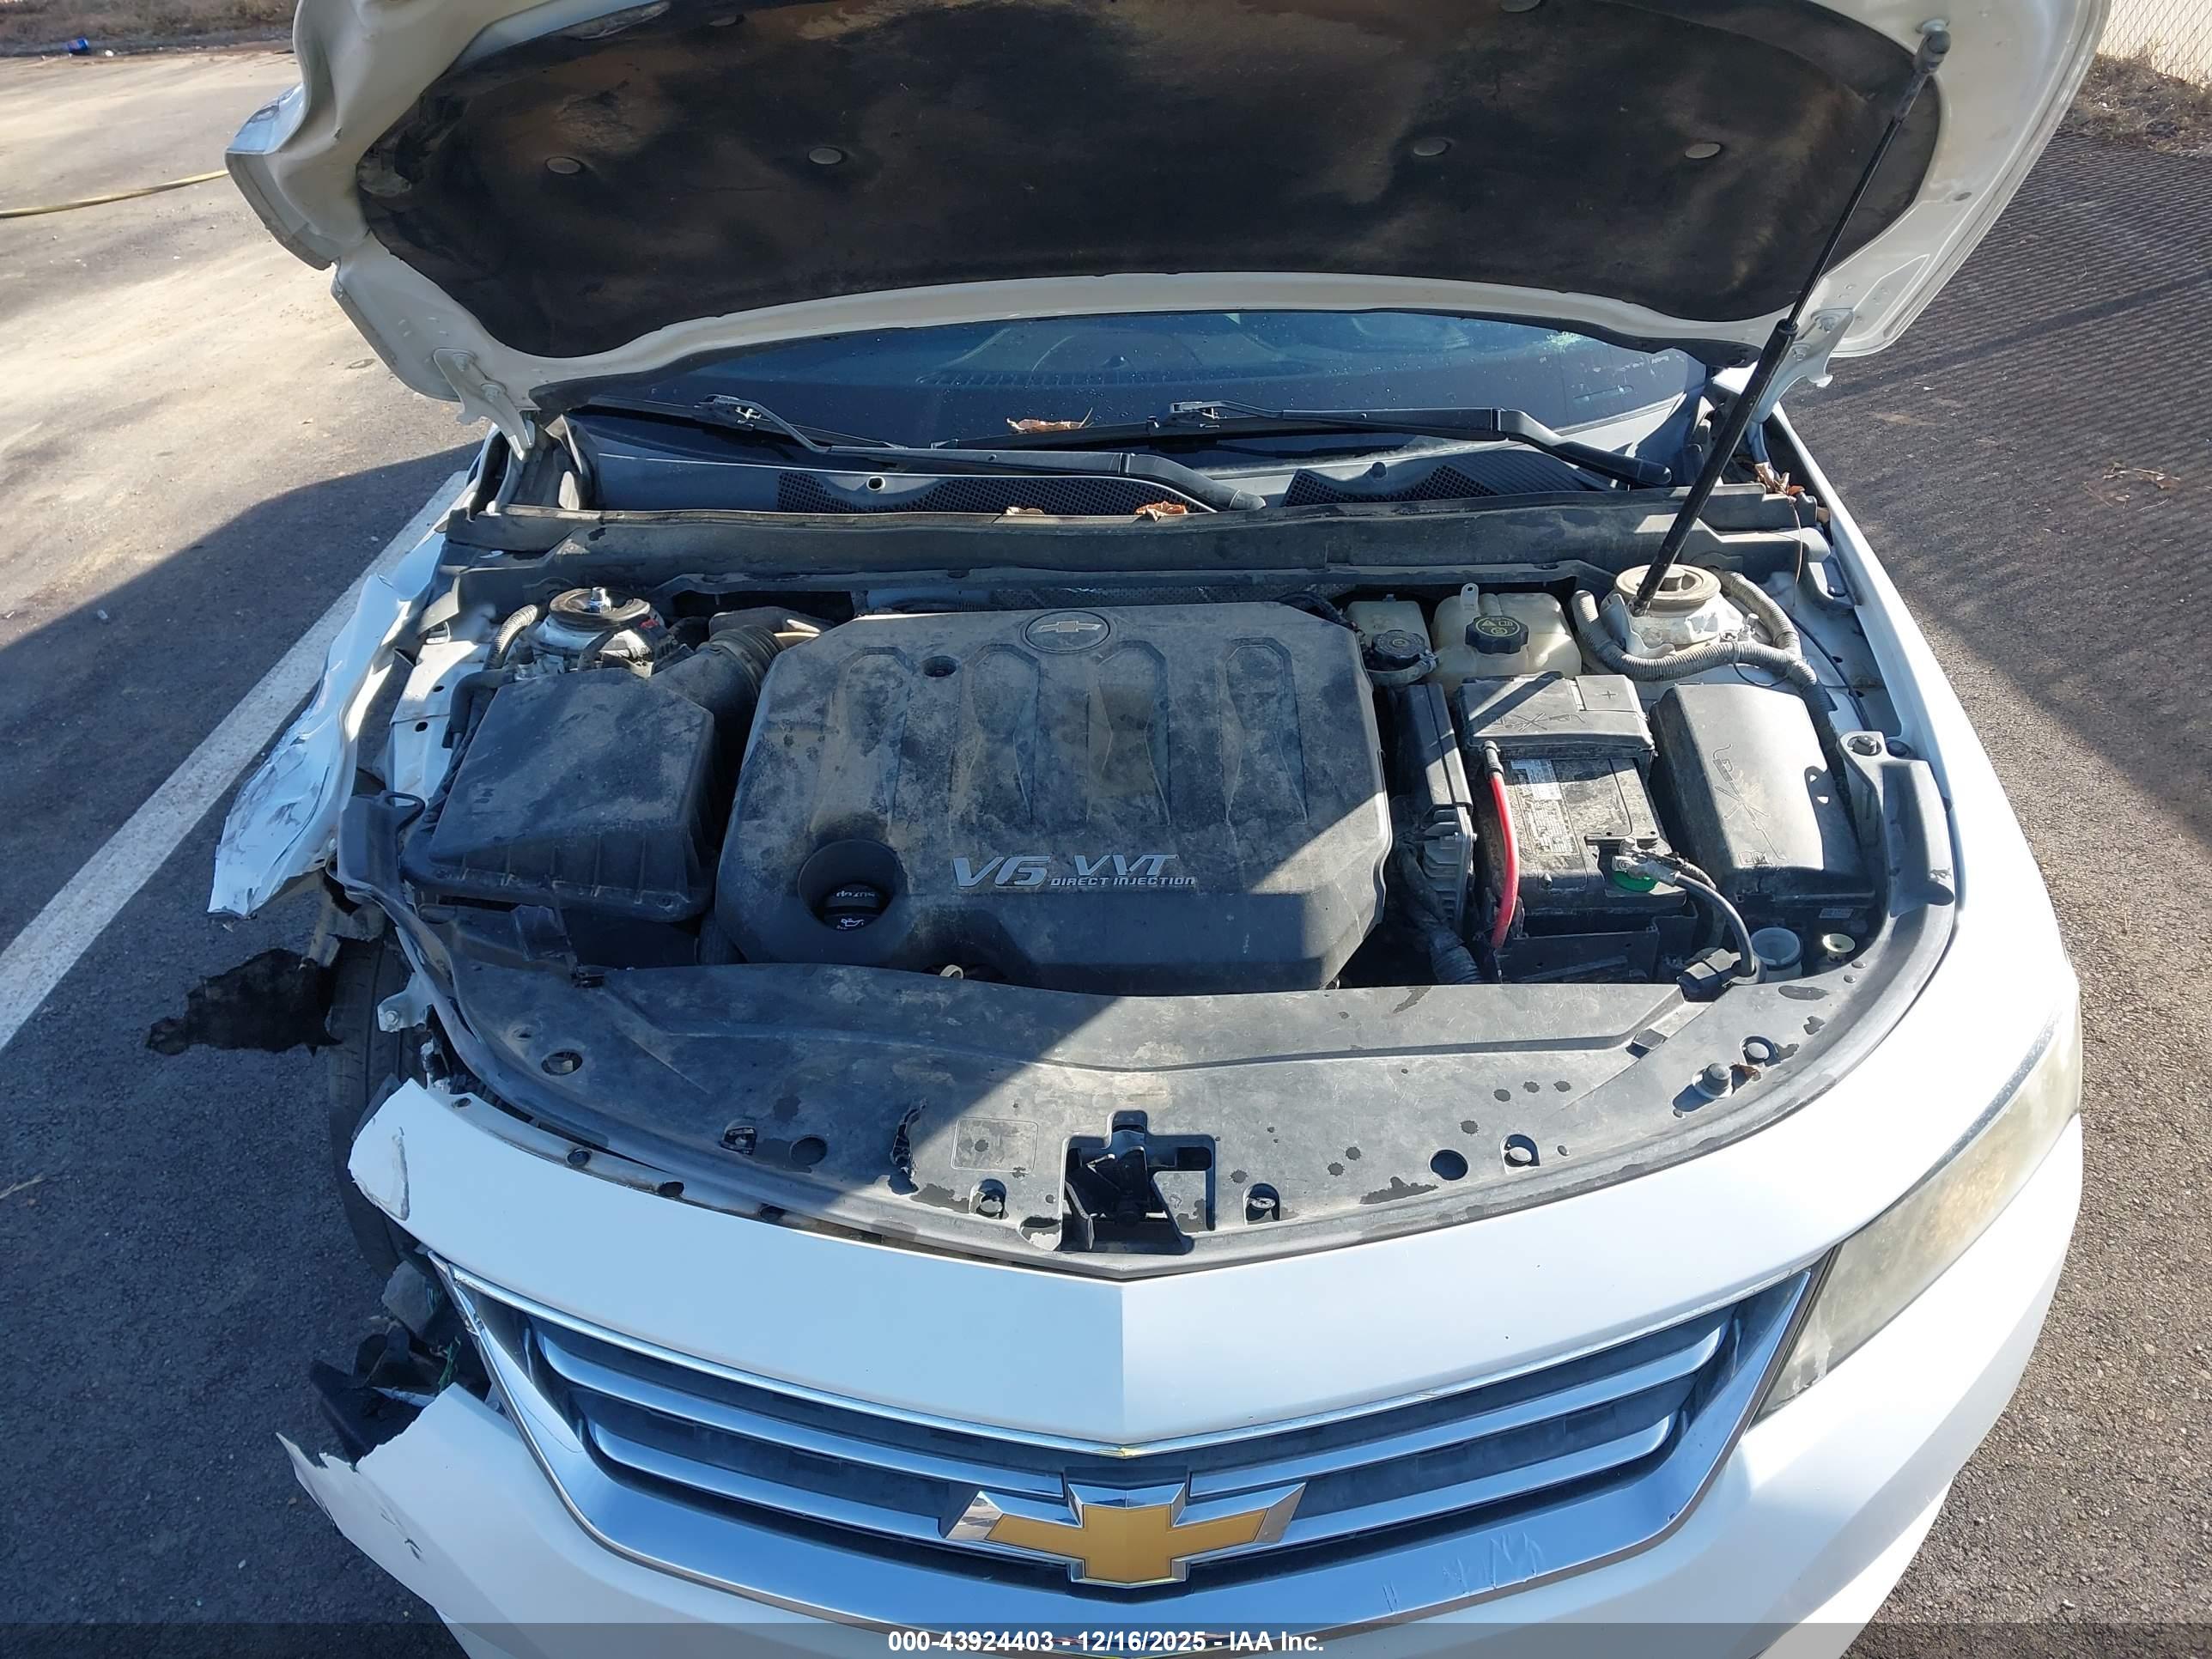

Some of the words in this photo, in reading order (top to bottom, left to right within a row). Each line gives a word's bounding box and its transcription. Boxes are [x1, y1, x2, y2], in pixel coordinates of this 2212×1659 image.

[952, 854, 1052, 887] V6
[1073, 854, 1180, 877] VVT
[1049, 877, 1109, 887] DIRECT
[1112, 876, 1196, 886] INJECTION
